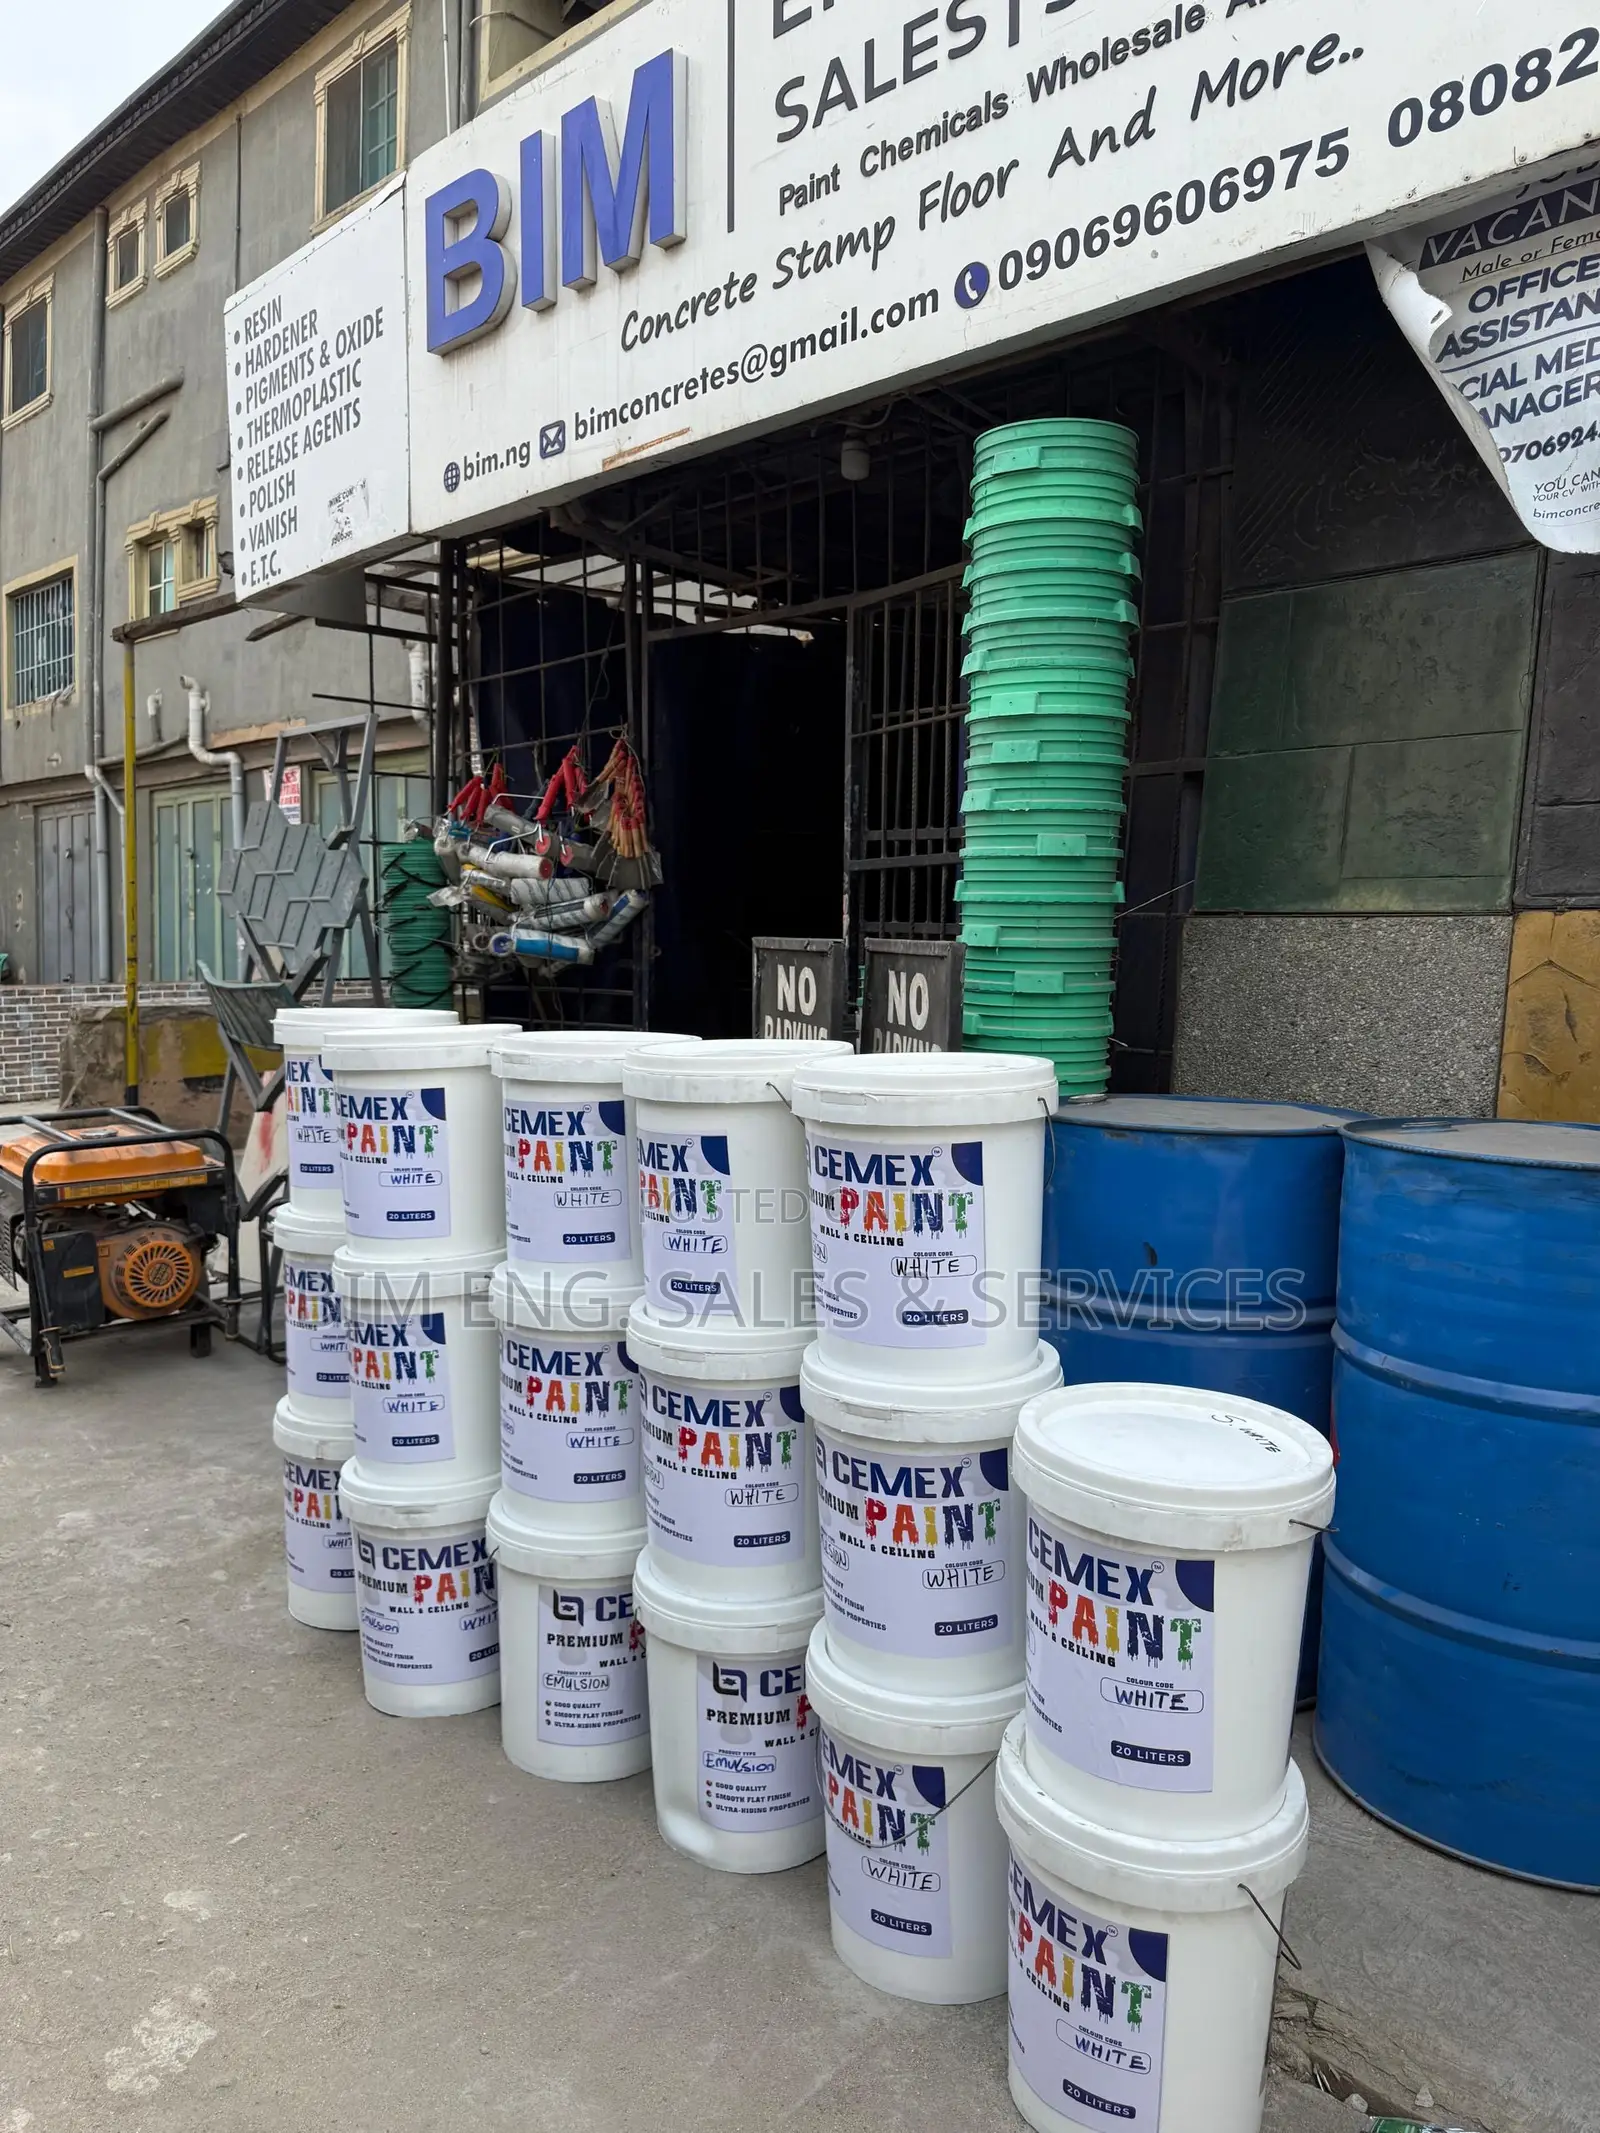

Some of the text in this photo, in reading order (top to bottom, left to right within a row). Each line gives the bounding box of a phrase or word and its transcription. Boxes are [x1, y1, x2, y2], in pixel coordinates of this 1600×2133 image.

[775, 0, 987, 143] SALES
[778, 162, 841, 217] Paint
[1026, 3, 1206, 103] Wholesale
[425, 47, 687, 356] BIM
[620, 33, 1364, 352] Concrete Stamp Floor And More..
[1427, 178, 1600, 264] VACAN
[463, 25, 1600, 482] bim.ng bimconcretes@gmail.com 09069606975 08082
[1462, 248, 1543, 282] Male or
[1468, 253, 1600, 313] OFFICE
[244, 295, 282, 345] RESIN
[245, 308, 318, 378] HARDENER
[246, 306, 384, 414] PIGMENTS & OXIDE
[246, 358, 362, 448] THERMOPLASTIC
[247, 397, 361, 484] RELEASE AGENTS
[250, 469, 296, 518] POLISH
[1533, 491, 1559, 502] YOUR
[1562, 488, 1575, 497] CV
[1535, 476, 1567, 494] YOU
[249, 505, 298, 552] VANISH
[251, 550, 282, 587] E.T.C.
[777, 964, 817, 1016] NO
[888, 963, 929, 1031] NO
[504, 1106, 586, 1136] CEMEX
[297, 1129, 331, 1143] WHITE
[347, 1123, 439, 1156] PAINT
[355, 1153, 388, 1165] CEILING
[518, 1138, 618, 1175] PAINT
[814, 1145, 935, 1187] CEMEX
[309, 1165, 332, 1173] LITERS
[390, 1172, 436, 1185] WHITE
[527, 1174, 564, 1184] CEILING
[556, 1191, 611, 1207] WHITE
[389, 1211, 433, 1220] 20 LITERS
[840, 1186, 973, 1238] PAINT
[565, 1234, 612, 1243] 20 LITERS
[668, 1235, 723, 1254] WHITE
[820, 1225, 904, 1247] WALL CEILING
[896, 1257, 960, 1280] WHITE
[673, 1281, 717, 1292] 20 LITERS
[907, 1313, 964, 1323] 20 LITERS
[353, 1347, 440, 1382] PAINT
[507, 1339, 604, 1377] CEMEX
[361, 1381, 391, 1390] CEILING
[526, 1375, 633, 1415] PAINT
[387, 1400, 439, 1412] WHITE
[508, 1403, 578, 1424] WALL CEILING
[652, 1384, 766, 1428] CEMEX
[394, 1436, 437, 1445] 20 LITERS
[570, 1435, 620, 1448] WHITE
[678, 1425, 797, 1471] PAINT
[591, 1473, 623, 1482] LITERS
[656, 1455, 738, 1480] WALL CEILING
[833, 1450, 965, 1499] CEMEX
[730, 1488, 785, 1506] WHITE
[301, 1518, 331, 1529] CEILING
[661, 1524, 693, 1542] PROPERTIES
[865, 1496, 1000, 1549] PAINT
[737, 1534, 788, 1546] 20 LITERS
[839, 1530, 935, 1559] WALL CEILING
[382, 1537, 487, 1571] CEMEX
[1028, 1517, 1154, 1606] CEMEX
[358, 1562, 497, 1604] PREMIUM PAIN
[926, 1565, 994, 1587] WHITE
[389, 1605, 415, 1614] WALL
[428, 1601, 470, 1614] CEILING
[847, 1611, 887, 1631] PROPERTIES
[939, 1619, 994, 1633] 20 LITERS
[1048, 1576, 1202, 1668] PAINT
[546, 1632, 624, 1648] PREMIUM
[1030, 1609, 1117, 1668] WALL CEILING
[471, 1652, 482, 1660] 20
[599, 1657, 628, 1668] WALL
[545, 1674, 609, 1691] EMULSION
[1126, 1676, 1174, 1689] COLOUR CODE
[1115, 1685, 1189, 1711] WHITE
[601, 1709, 624, 1718] FINISH
[603, 1713, 641, 1727] PROPERTIES
[706, 1708, 791, 1726] PREMIUM
[764, 1735, 796, 1748] WALL
[706, 1753, 775, 1773] Emulsion
[1116, 1744, 1185, 1763] 20 LITERS
[715, 1782, 734, 1790] GOOD
[715, 1793, 744, 1803] SMOOTH
[767, 1792, 791, 1802] FINISH
[715, 1796, 811, 1814] ULTRA-HIDING PROPERTIES
[827, 1771, 935, 1853] PAINT
[867, 1858, 933, 1891] WHITE
[874, 1912, 928, 1933] 20 LITERS
[1018, 1911, 1152, 2030] PAINT
[1026, 1969, 1070, 2013] CEILING
[1078, 2025, 1123, 2047] COLOUR CODE
[1075, 2034, 1147, 2071] WHITE
[1066, 2085, 1130, 2117] 20 LITERS
